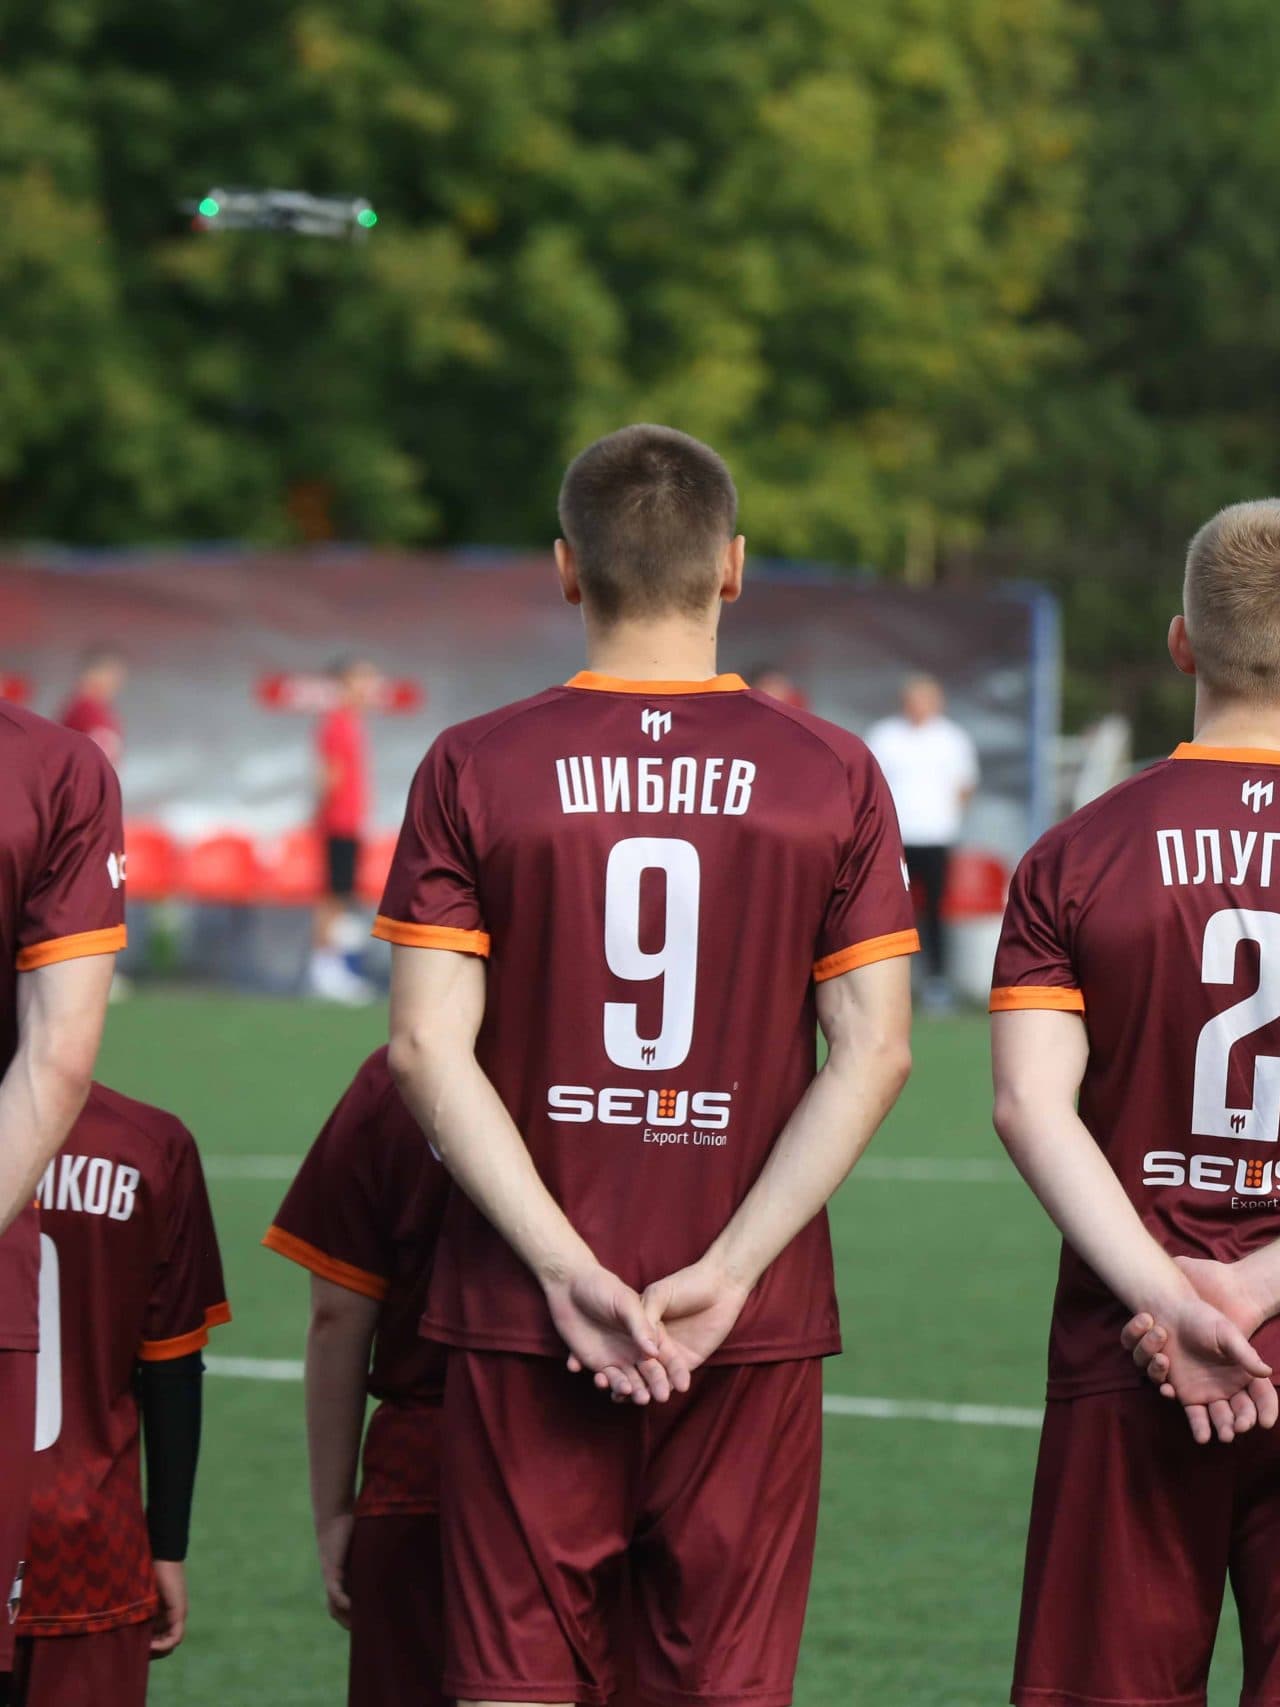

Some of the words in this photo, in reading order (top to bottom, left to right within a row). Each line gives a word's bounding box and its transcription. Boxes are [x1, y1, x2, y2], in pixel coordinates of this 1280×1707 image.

[556, 756, 756, 815] ШИБАЕВ
[604, 837, 700, 1071] 9
[548, 1085, 732, 1129] SEUS
[643, 1129, 689, 1146] Export
[693, 1132, 727, 1147] Union
